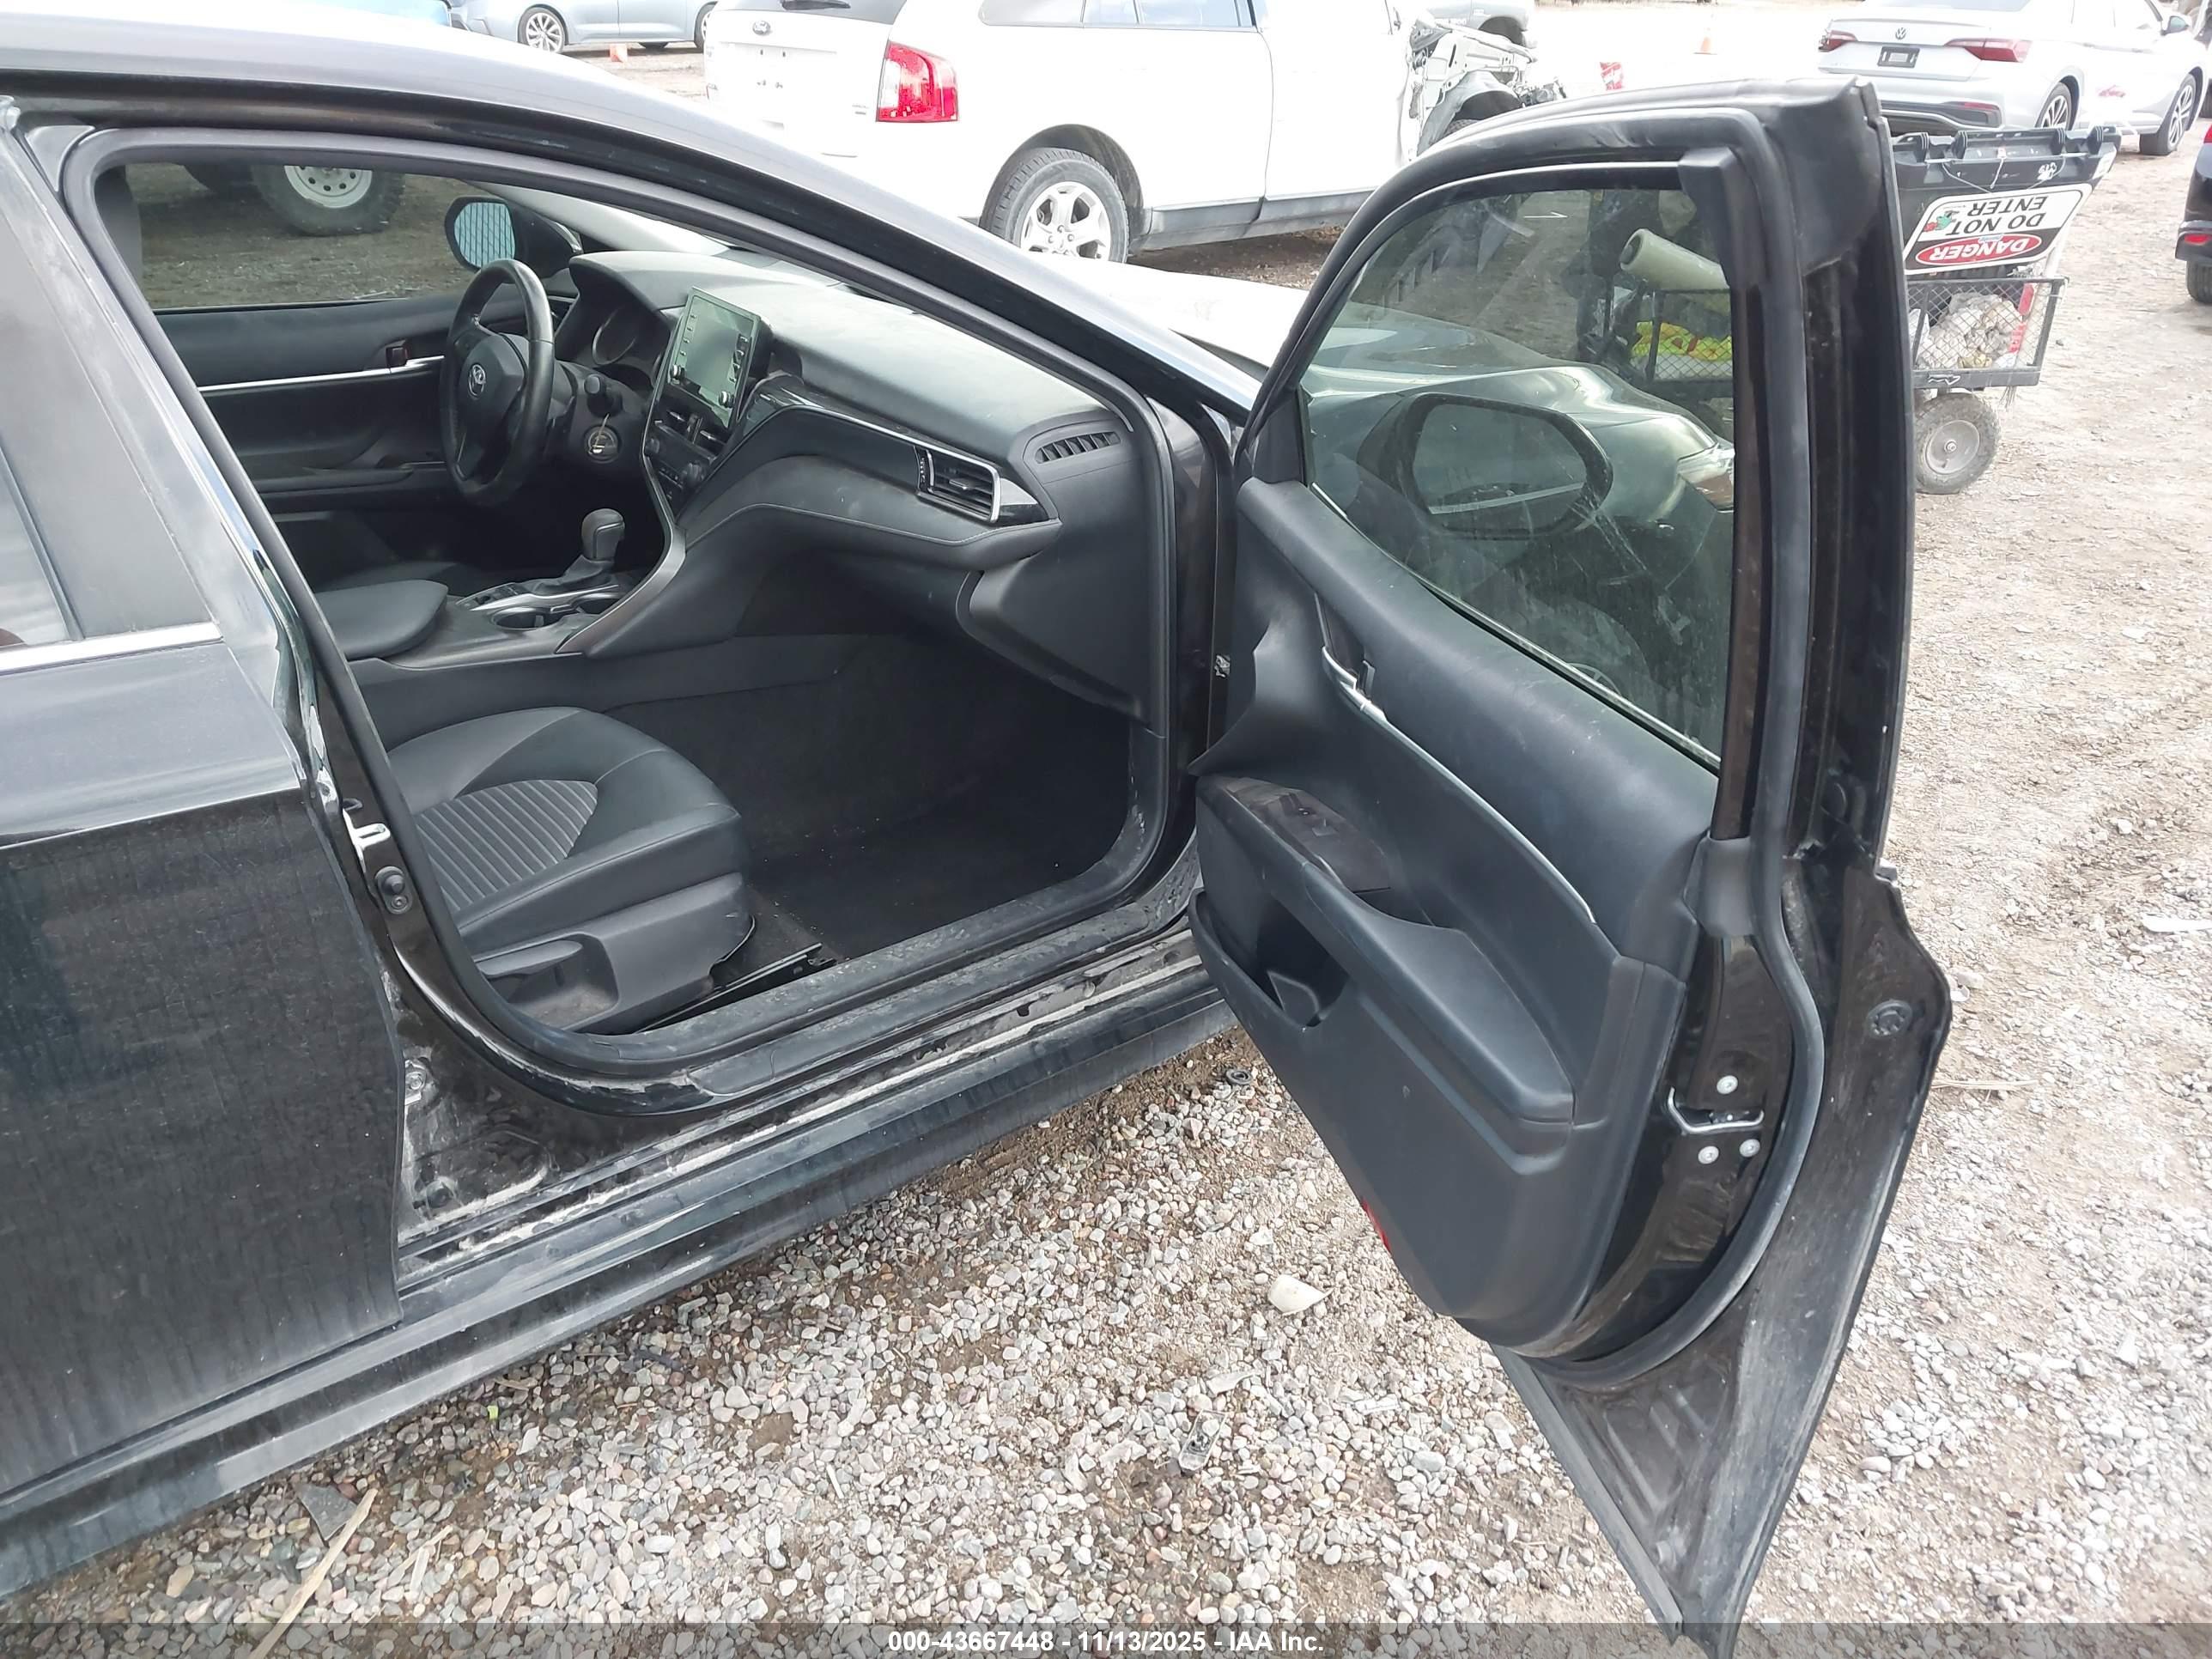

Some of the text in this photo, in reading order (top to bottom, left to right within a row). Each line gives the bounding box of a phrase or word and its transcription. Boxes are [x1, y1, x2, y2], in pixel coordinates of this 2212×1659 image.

[1967, 196, 2049, 216] ENTER
[1945, 212, 2046, 236] DO NOT
[1929, 237, 2030, 261] DANGER
